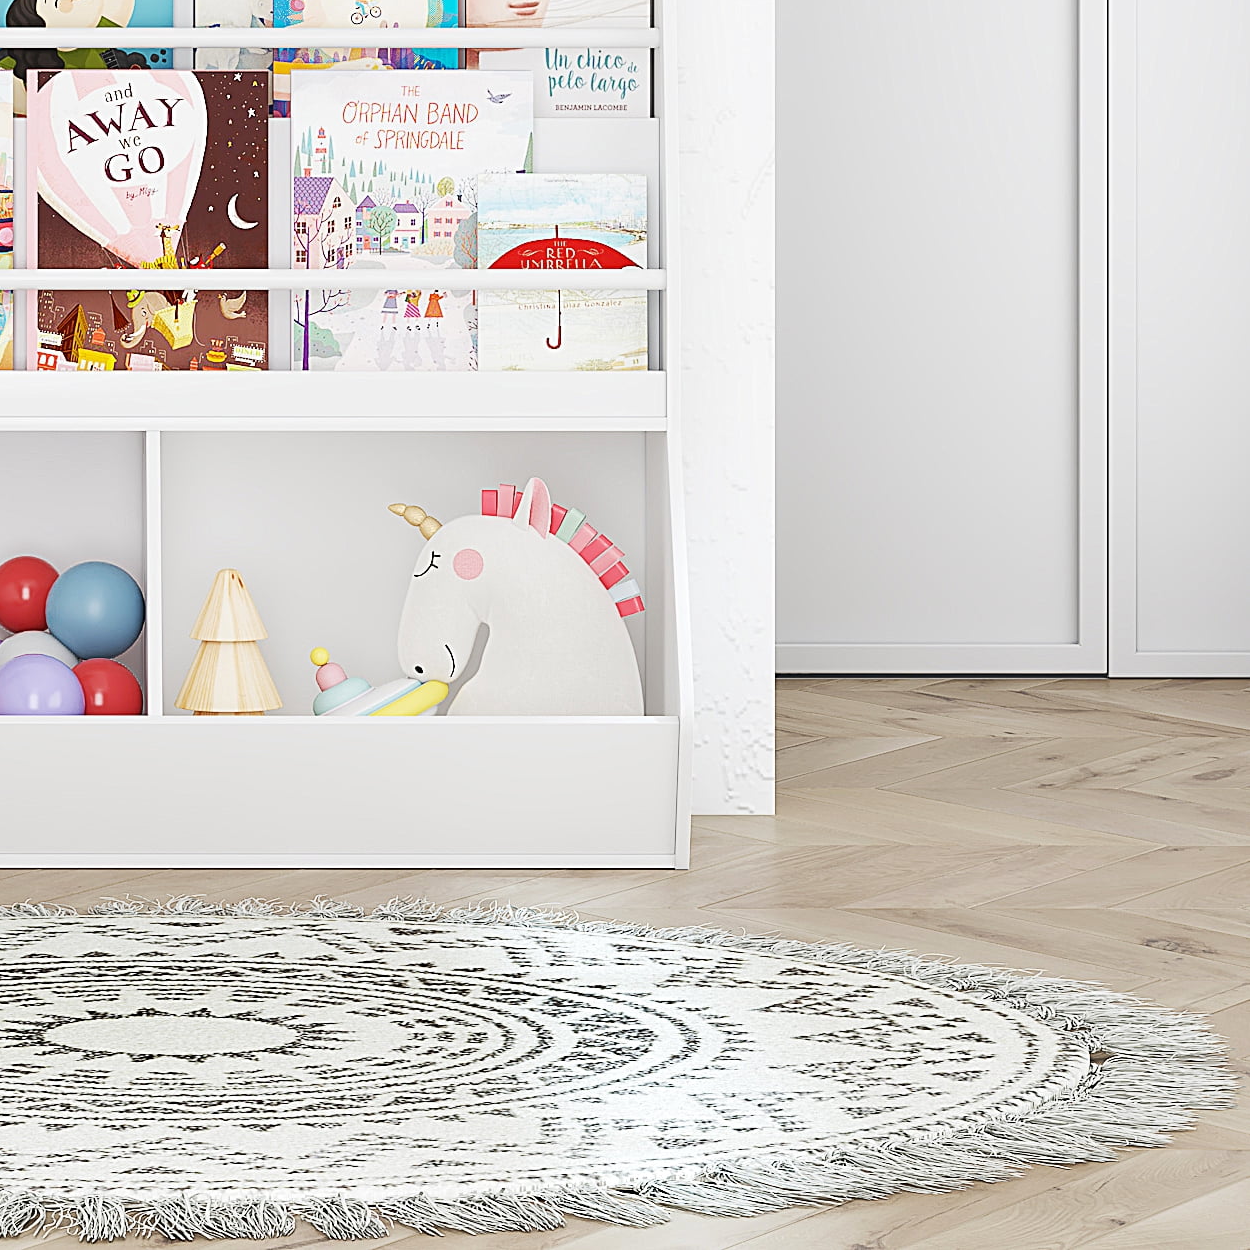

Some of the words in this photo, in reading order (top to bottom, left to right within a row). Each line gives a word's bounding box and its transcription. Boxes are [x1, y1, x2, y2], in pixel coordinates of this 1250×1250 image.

[545, 48, 572, 70] Un
[577, 48, 626, 69] chico
[628, 62, 638, 73] de
[104, 82, 133, 102] and
[401, 85, 421, 97] THE
[548, 70, 586, 97] pelo
[590, 72, 639, 99] largo
[342, 100, 418, 124] ORPHAN
[427, 102, 479, 125] BAND
[67, 98, 185, 154] AWAY
[118, 135, 142, 150] we
[355, 131, 368, 145] of
[374, 129, 465, 150] SPRINGDALE
[104, 146, 165, 182] GO
[546, 247, 576, 259] RED
